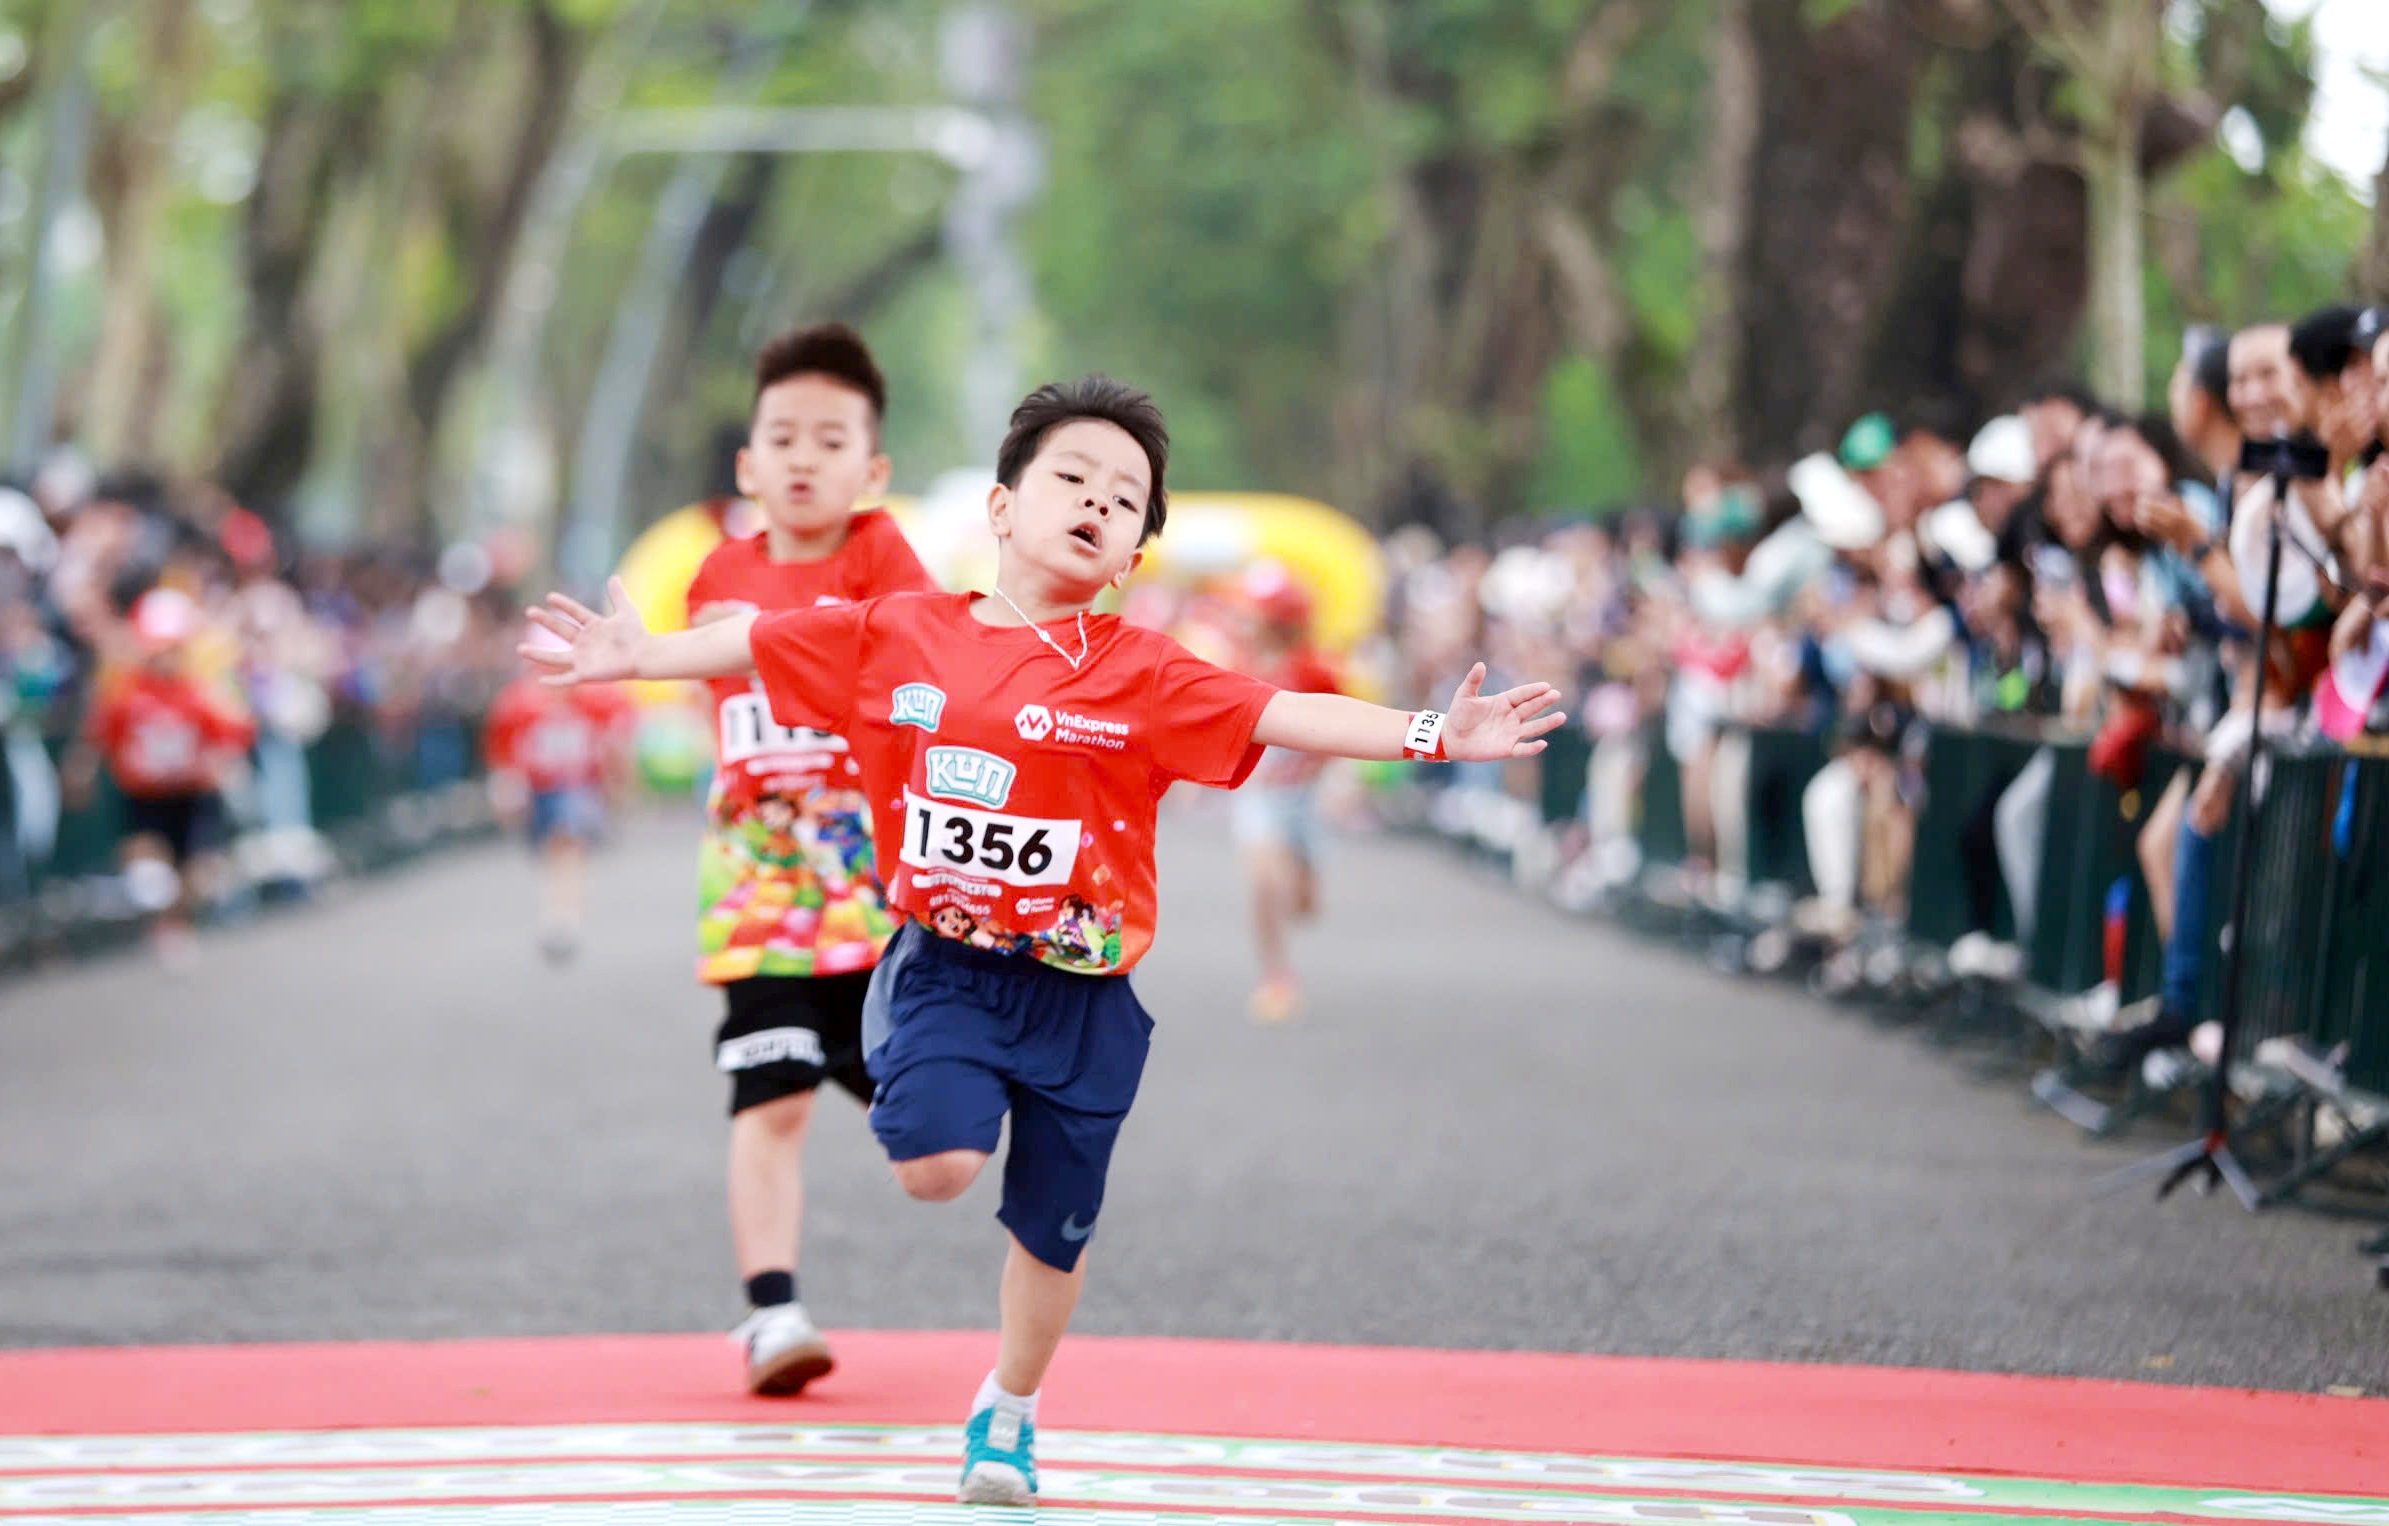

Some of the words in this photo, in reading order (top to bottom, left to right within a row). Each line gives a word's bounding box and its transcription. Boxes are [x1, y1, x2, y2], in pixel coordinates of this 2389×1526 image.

[1055, 710, 1130, 736] VnExpress
[1055, 727, 1126, 750] Marathon
[918, 808, 1053, 876] 1356
